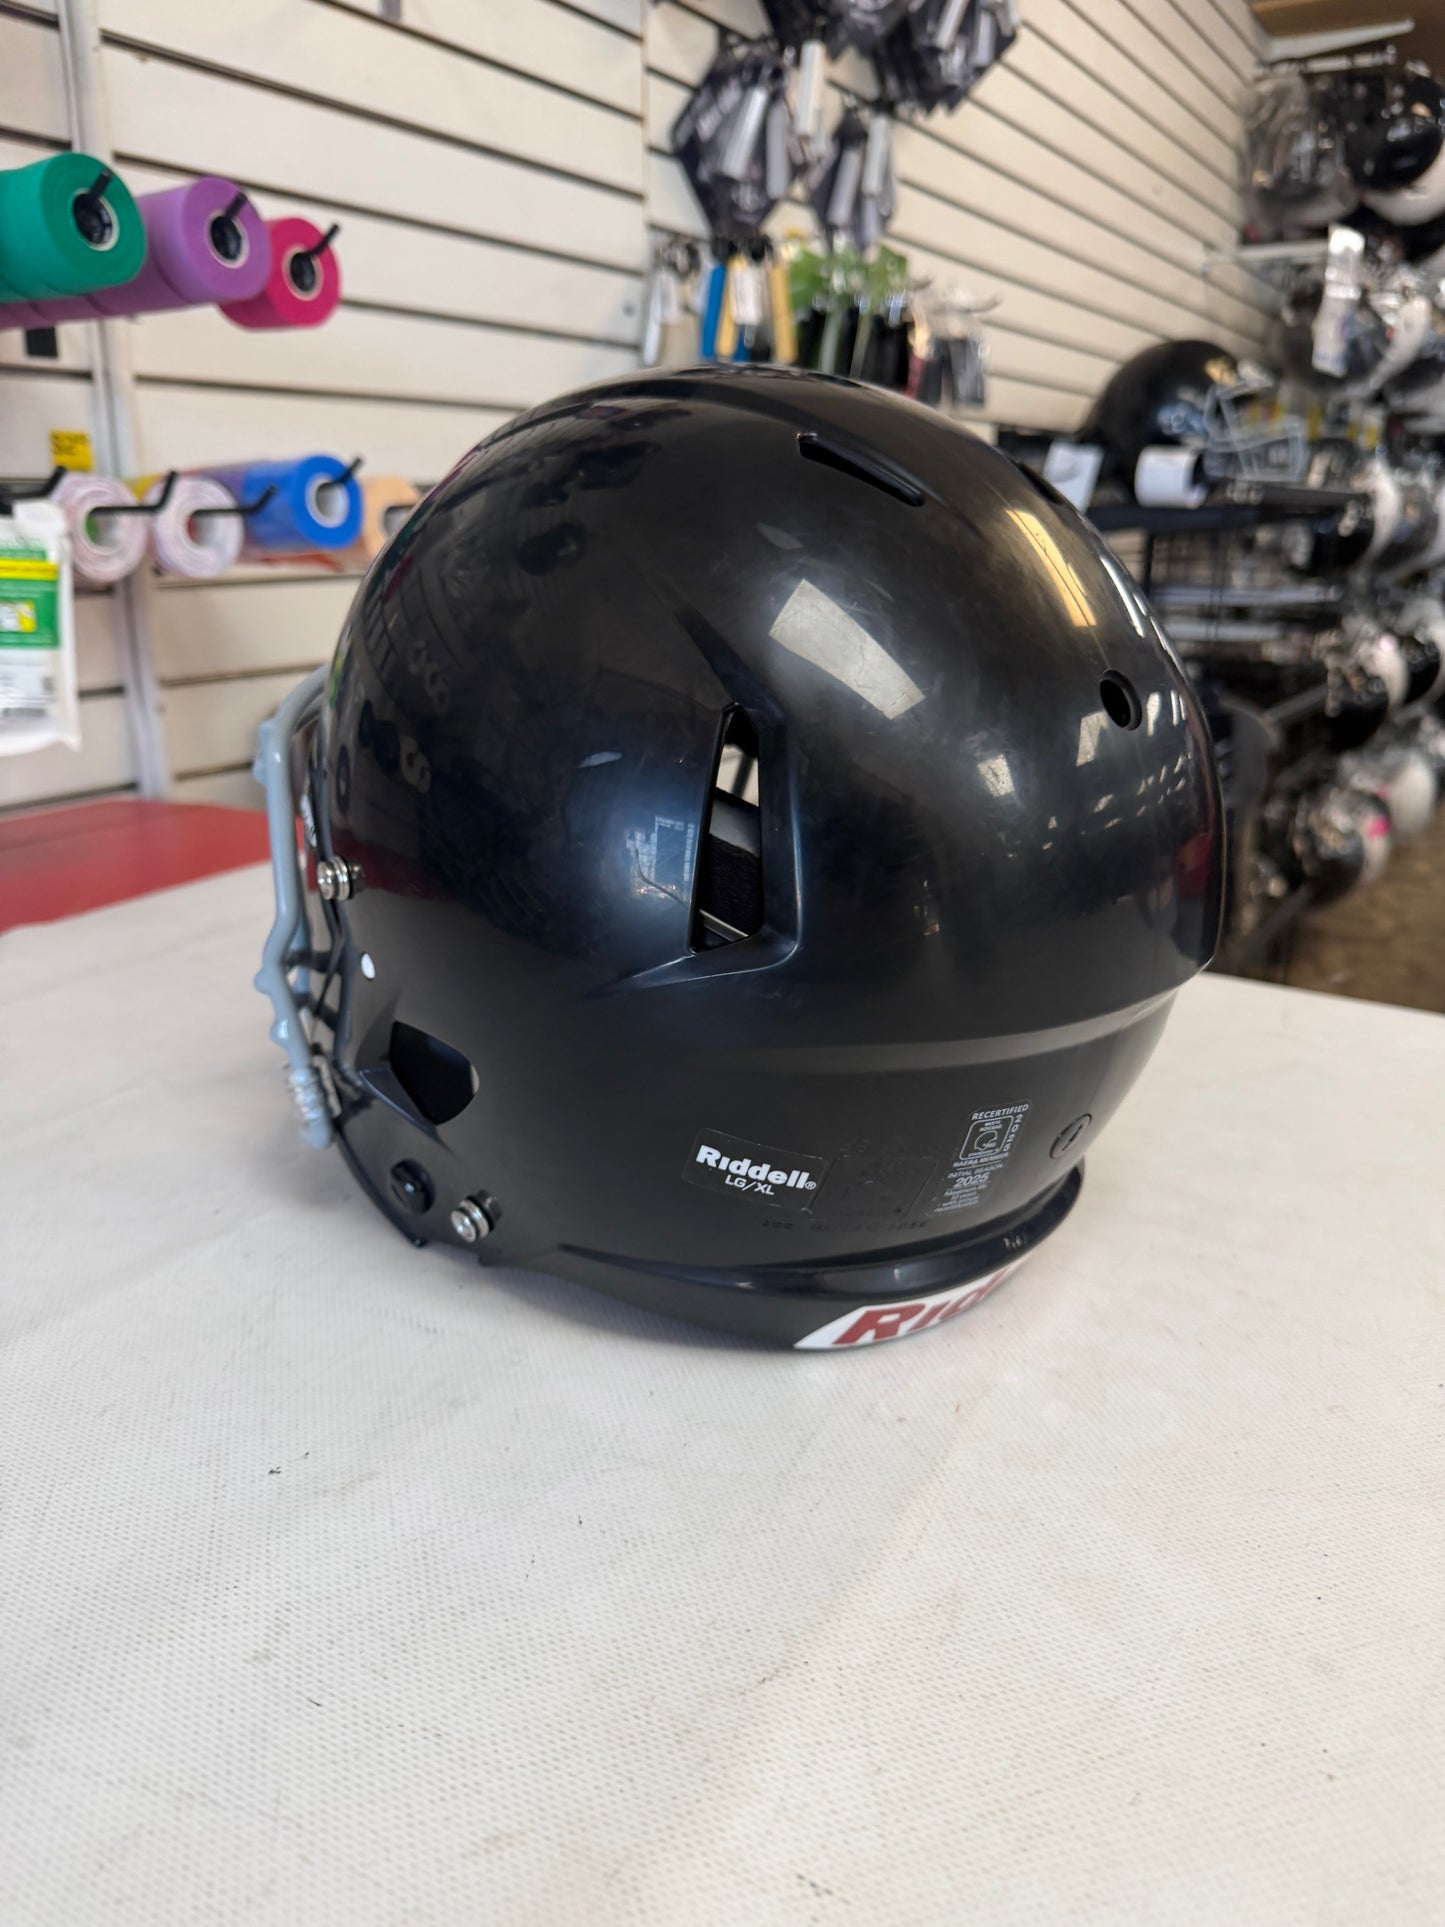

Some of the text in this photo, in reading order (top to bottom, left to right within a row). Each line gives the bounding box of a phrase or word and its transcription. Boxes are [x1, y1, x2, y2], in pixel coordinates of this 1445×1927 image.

[972, 1104, 1029, 1120] RECERTIFIED
[724, 1174, 775, 1196] LG/XL
[954, 1172, 990, 1187] 2025
